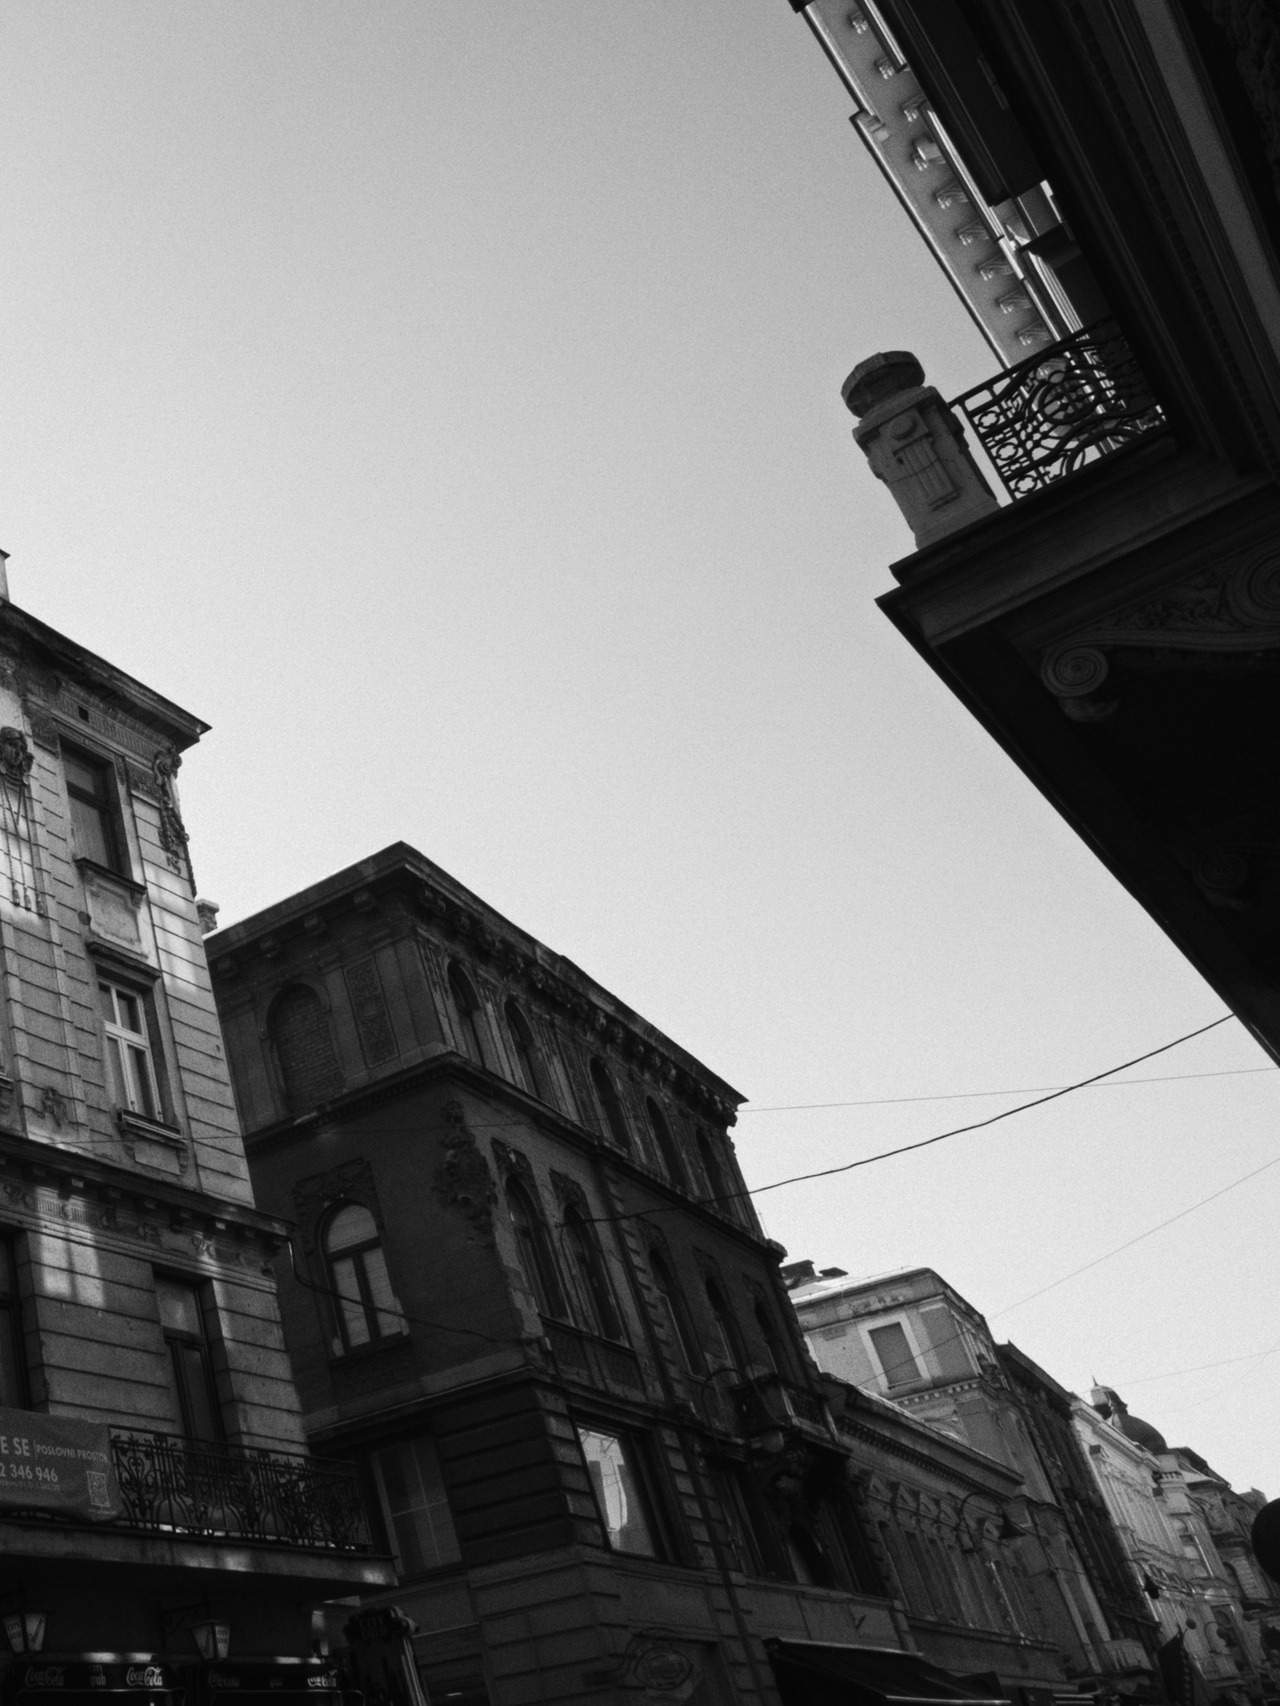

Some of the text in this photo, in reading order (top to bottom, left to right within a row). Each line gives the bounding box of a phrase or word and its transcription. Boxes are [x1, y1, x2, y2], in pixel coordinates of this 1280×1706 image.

[12, 1437, 31, 1457] SE
[36, 1444, 76, 1458] POSLOVNI
[10, 1463, 33, 1480] 346
[35, 1466, 59, 1482] 946
